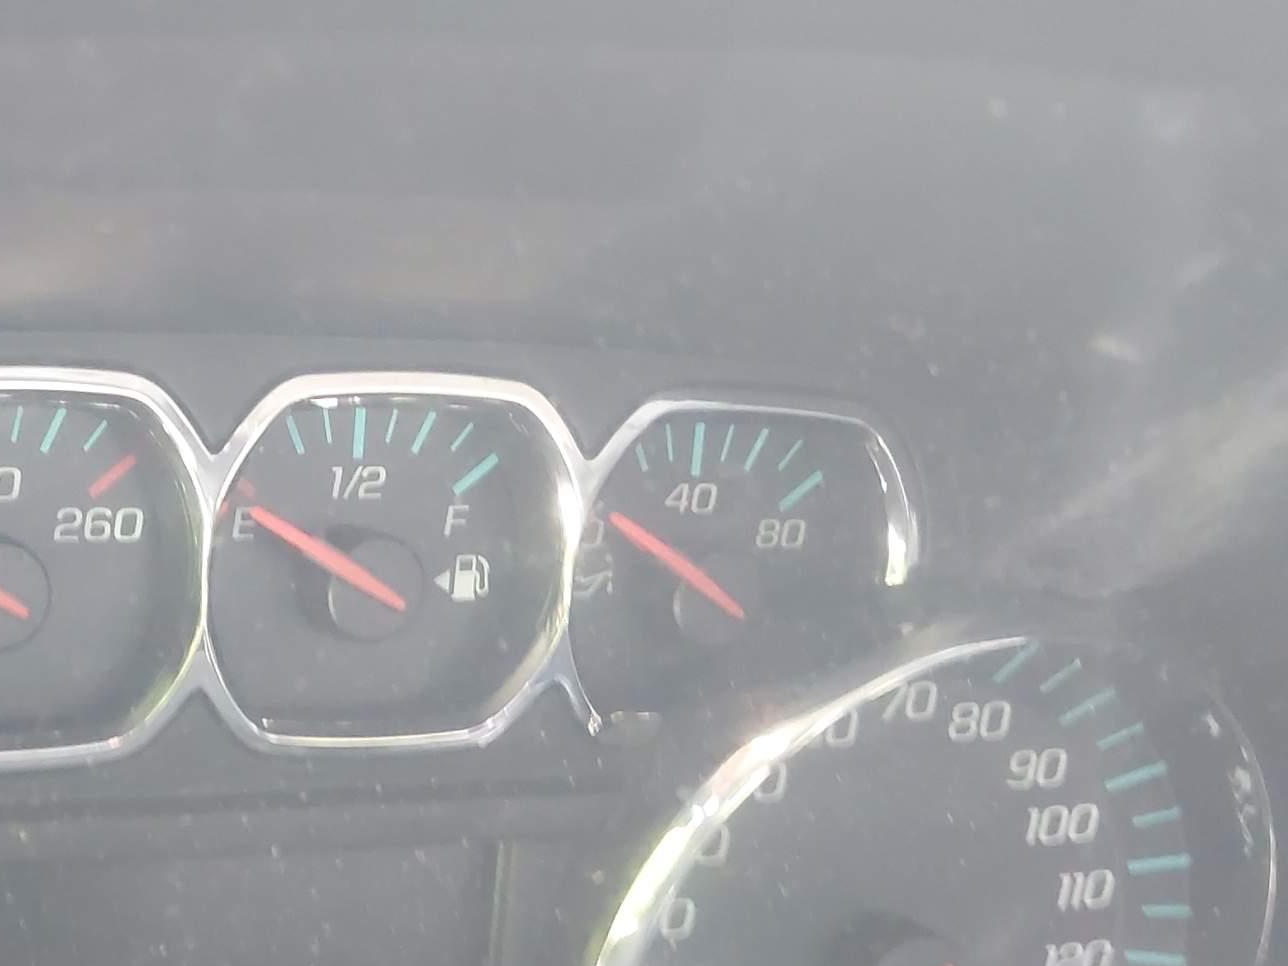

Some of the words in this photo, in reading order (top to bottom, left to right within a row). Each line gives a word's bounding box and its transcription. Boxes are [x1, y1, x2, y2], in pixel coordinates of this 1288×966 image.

[331, 465, 386, 500] 1/2
[664, 482, 718, 514] 40
[54, 506, 144, 543] 260
[232, 507, 258, 540] E
[444, 504, 470, 537] F
[755, 518, 807, 549] 80
[948, 700, 1011, 743] 80
[1006, 748, 1068, 791] 90
[1026, 803, 1099, 846] 100
[1057, 869, 1114, 912] 110
